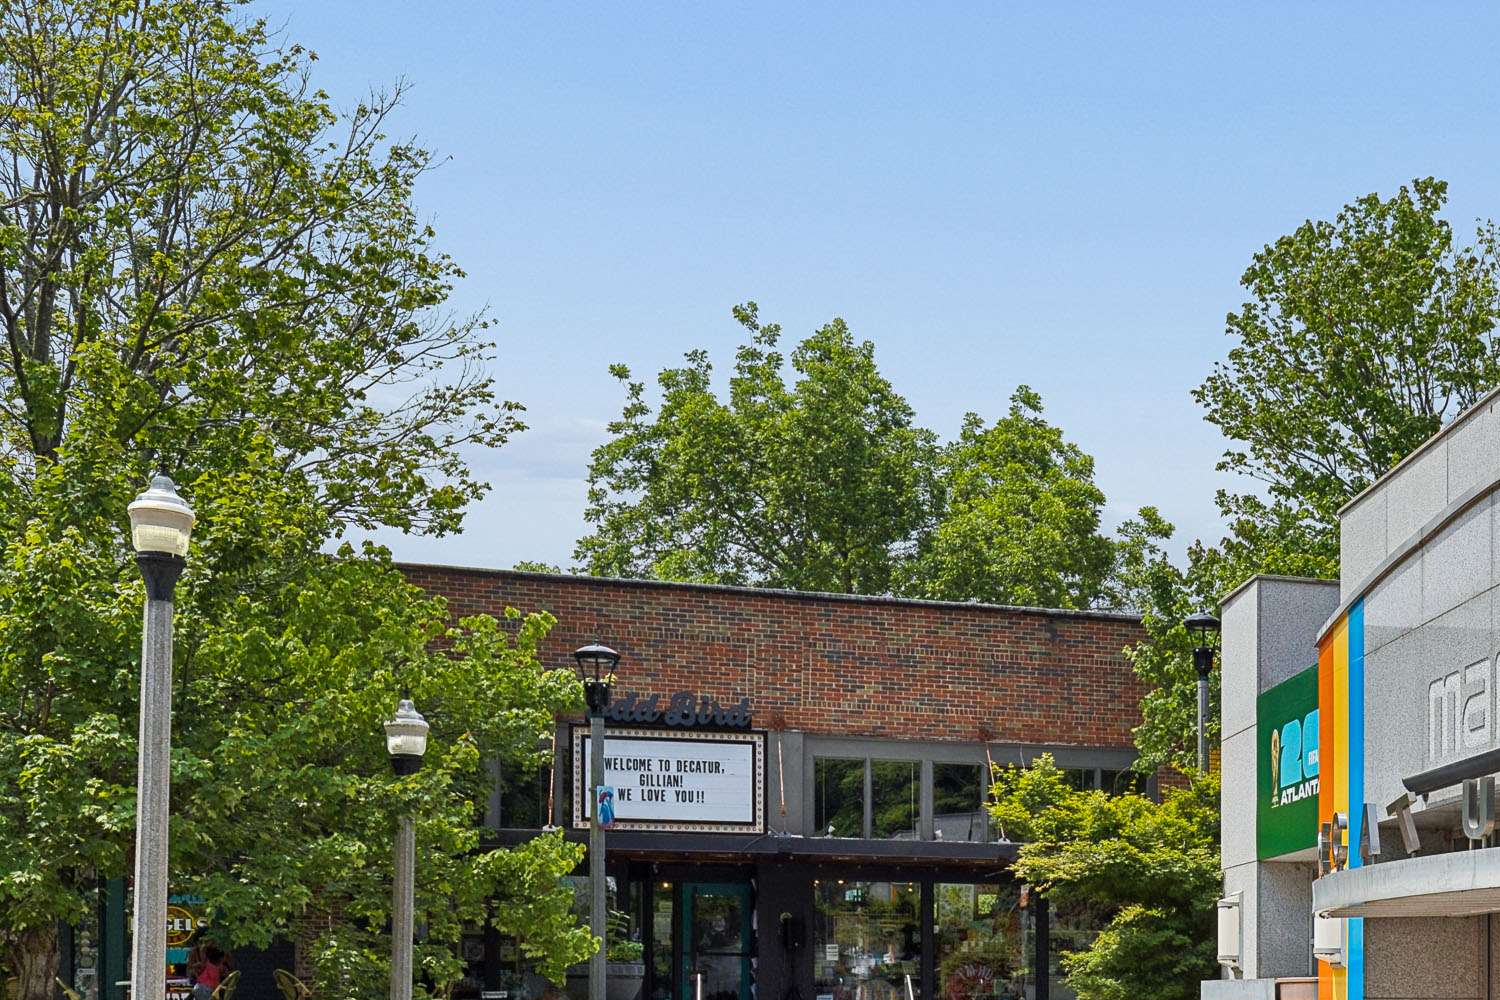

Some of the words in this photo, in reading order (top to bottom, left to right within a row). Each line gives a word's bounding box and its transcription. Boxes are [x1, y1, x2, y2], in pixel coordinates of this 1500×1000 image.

[664, 691, 754, 727] Bird
[604, 757, 652, 772] WELCOME
[658, 759, 671, 772] TO
[676, 760, 725, 774] DECATUR,
[639, 774, 683, 788] GILLIAN!
[618, 788, 632, 801] WE
[641, 789, 666, 802] LOVE
[675, 790, 705, 804] YOU!!
